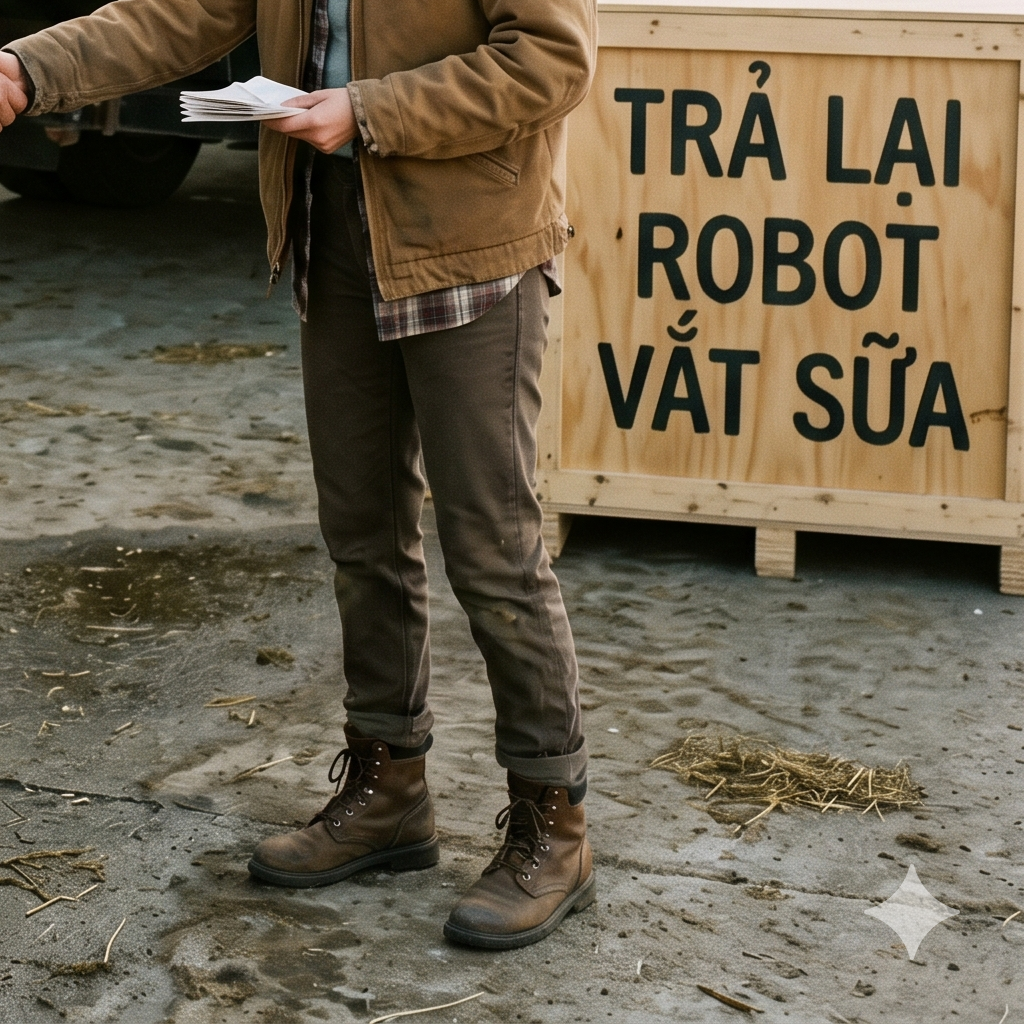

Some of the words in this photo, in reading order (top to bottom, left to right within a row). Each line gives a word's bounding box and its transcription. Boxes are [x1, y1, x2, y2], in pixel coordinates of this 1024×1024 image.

[614, 61, 787, 180] TRẢ
[826, 95, 962, 206] LẠI
[637, 212, 940, 312] ROBOT
[598, 310, 761, 436] VẮT
[793, 332, 970, 451] SỮA
